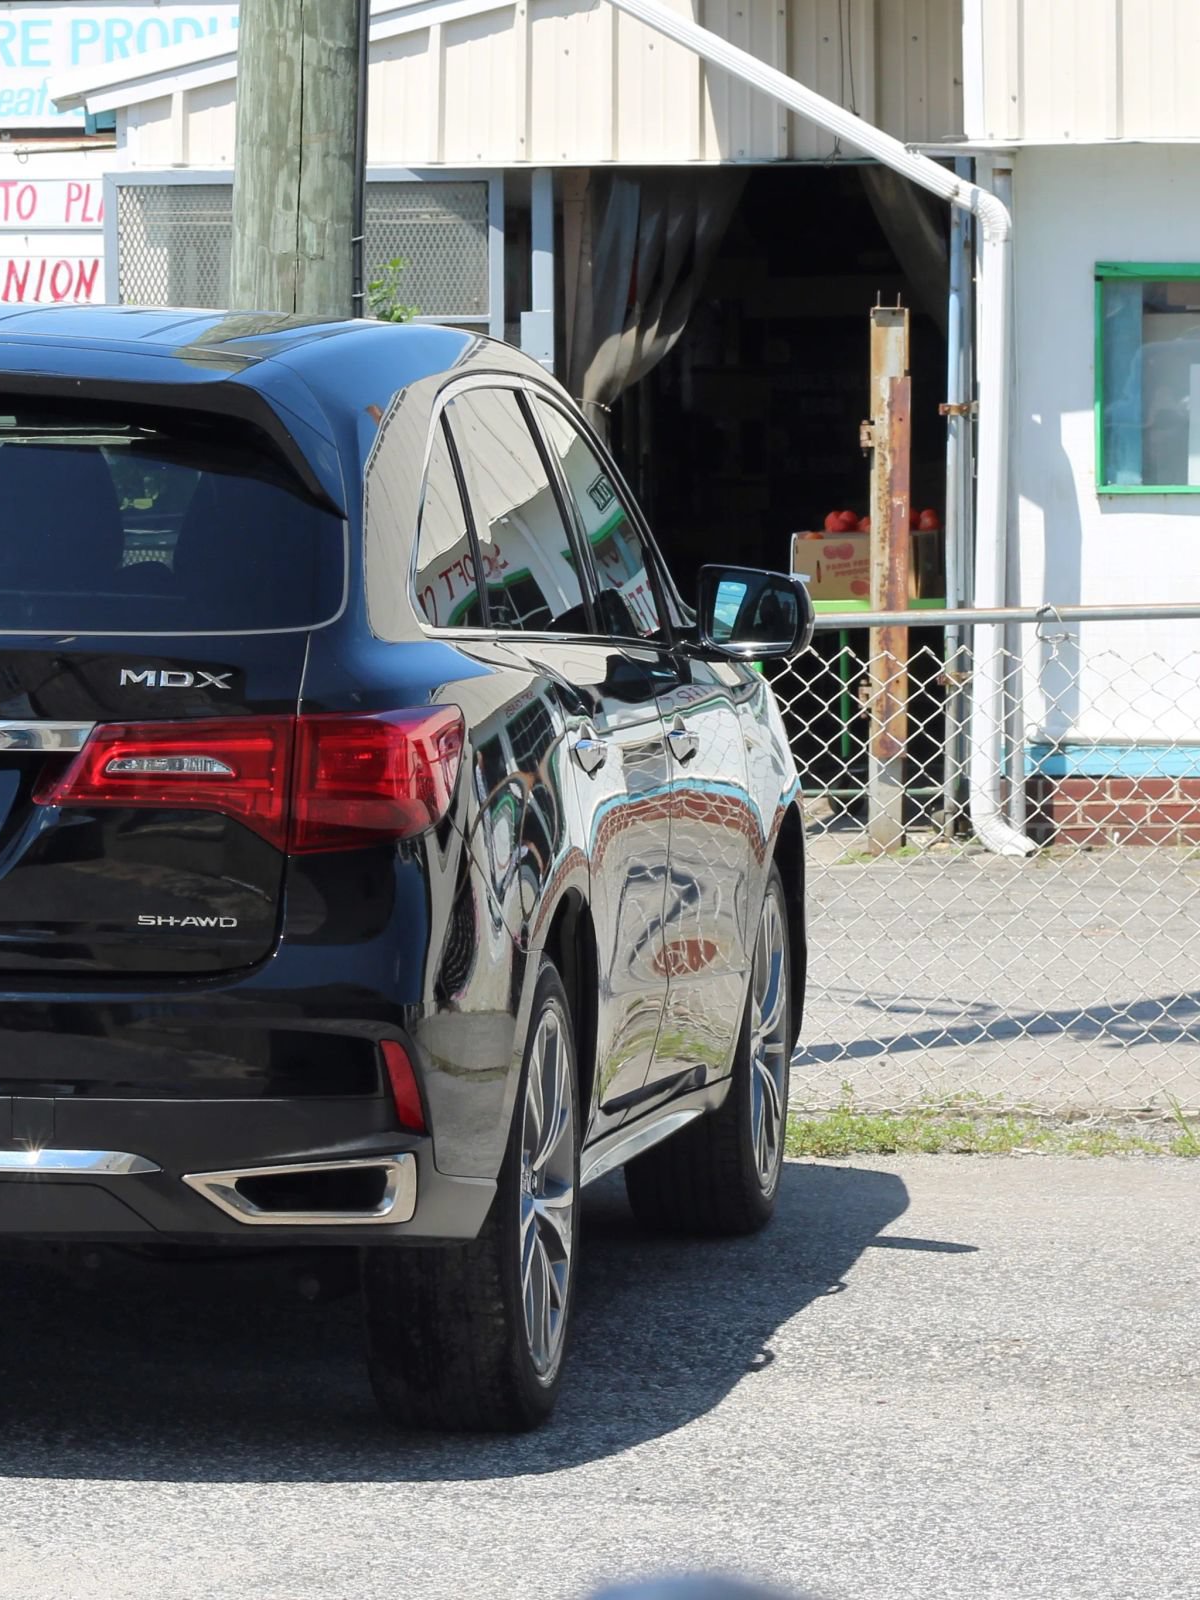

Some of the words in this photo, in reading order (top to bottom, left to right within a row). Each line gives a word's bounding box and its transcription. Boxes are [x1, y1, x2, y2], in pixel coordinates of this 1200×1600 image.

[71, 16, 241, 66] PROD
[120, 669, 233, 689] MDX
[137, 915, 238, 928] SH-AWD
